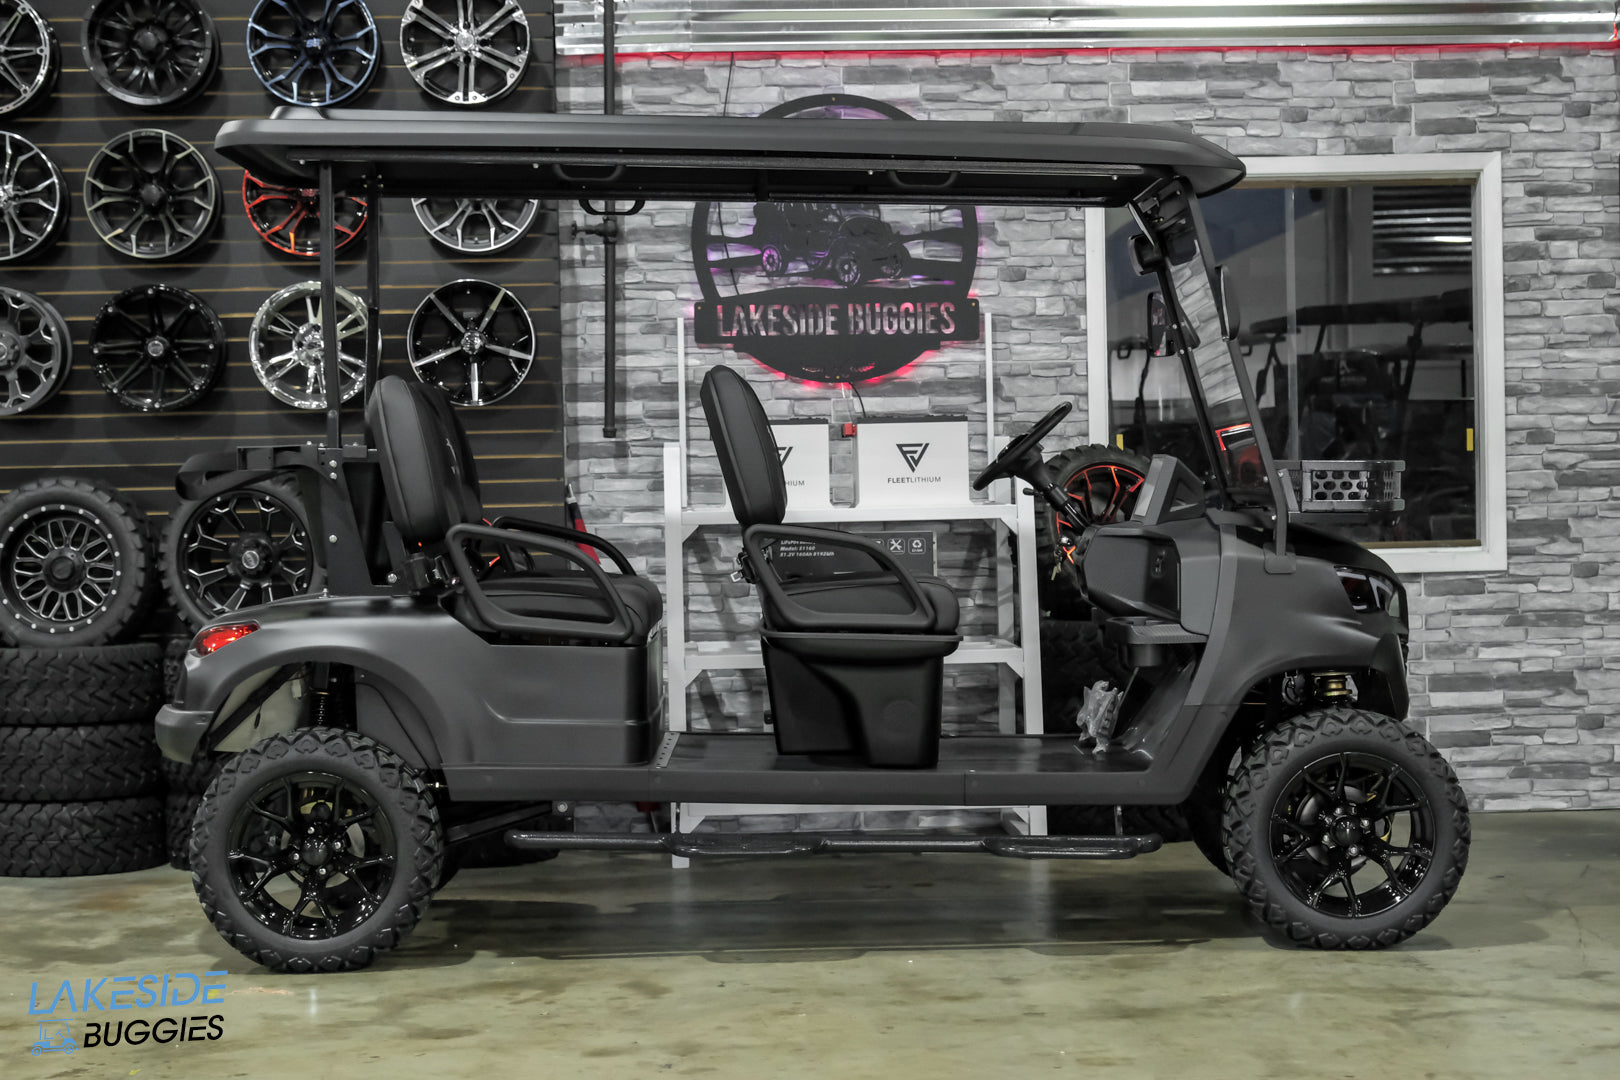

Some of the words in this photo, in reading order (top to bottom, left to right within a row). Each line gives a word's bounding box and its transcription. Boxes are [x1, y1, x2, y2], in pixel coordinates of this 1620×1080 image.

[717, 304, 839, 336] LAKESIDE
[848, 302, 955, 335] BUGGIES
[887, 476, 941, 484] FLEETLITHIUM
